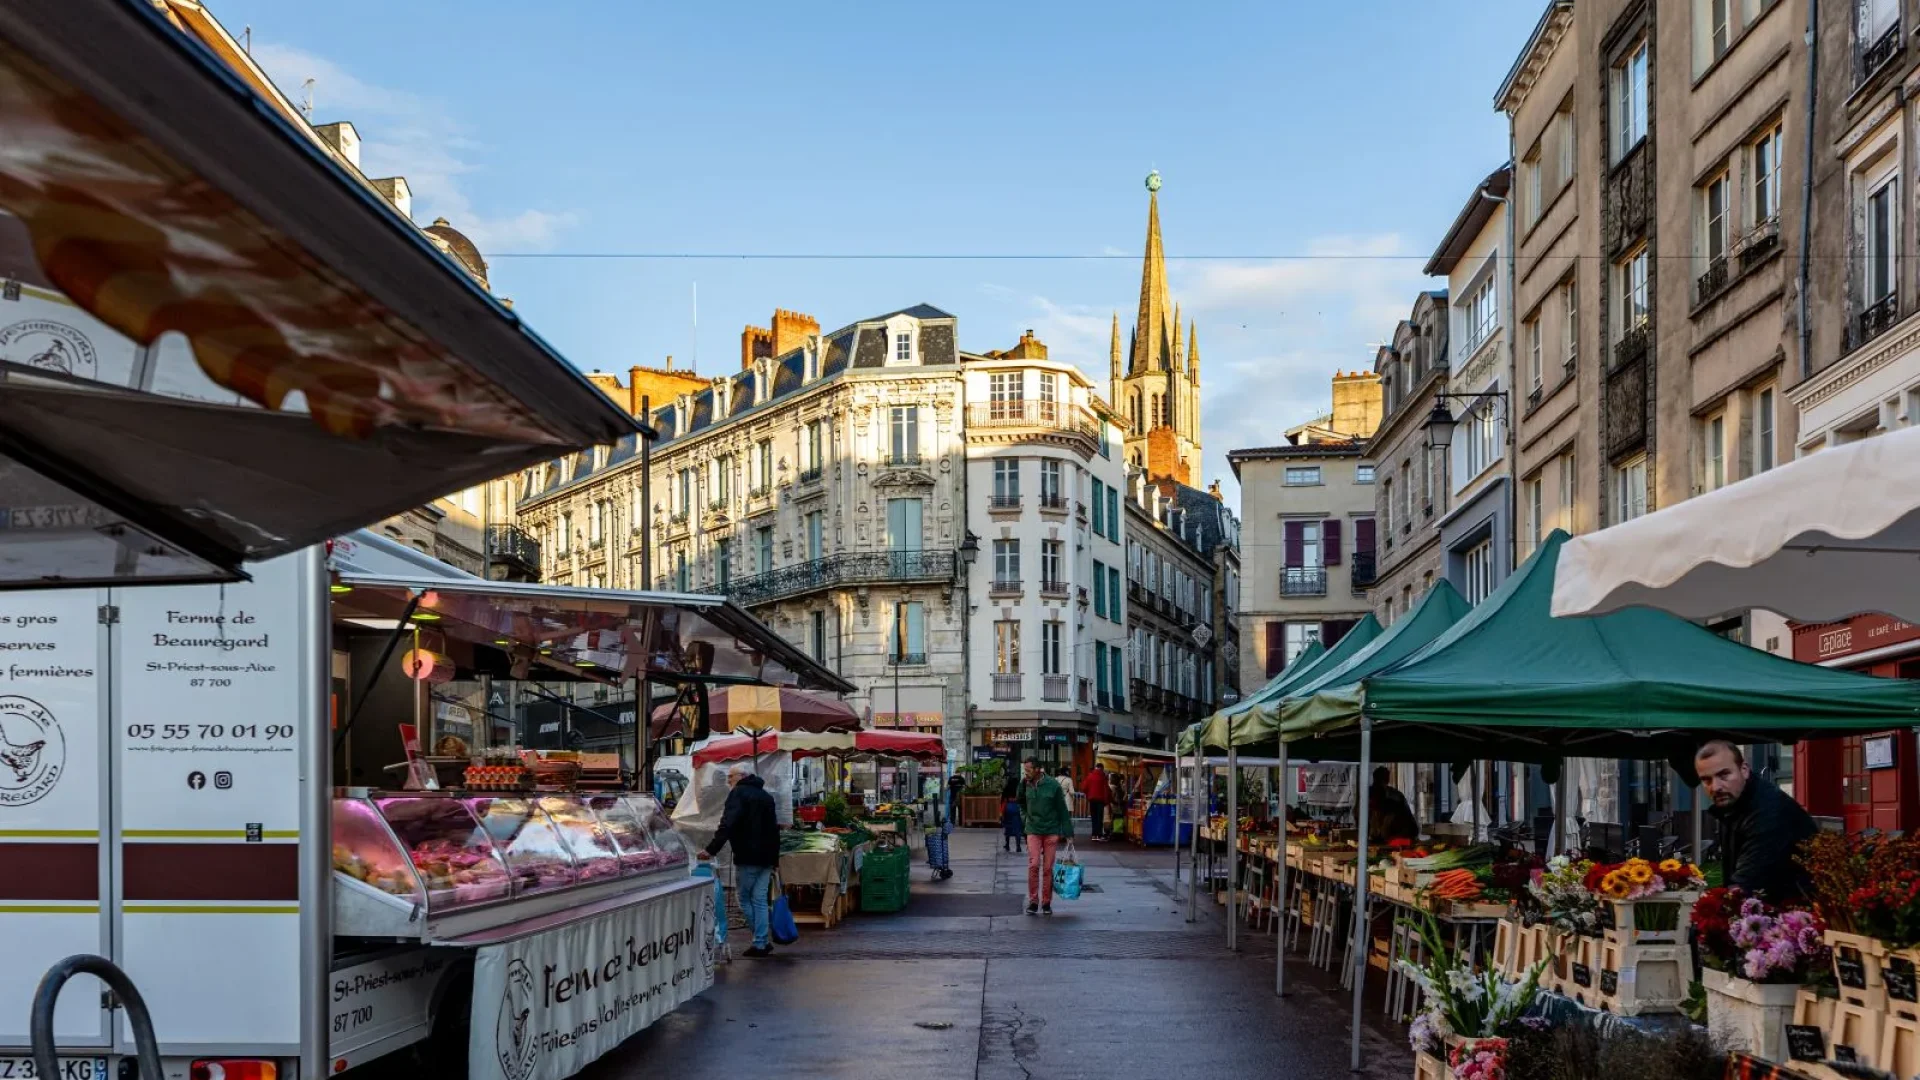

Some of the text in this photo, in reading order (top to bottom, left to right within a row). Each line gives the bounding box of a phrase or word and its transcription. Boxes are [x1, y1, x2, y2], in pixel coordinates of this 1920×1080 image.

[17, 615, 58, 628] gras
[166, 610, 255, 624] Ferme de
[0, 642, 56, 650] serves
[153, 633, 269, 651] Beauregard
[9, 664, 94, 681] fermières
[190, 678, 232, 687] 87 700
[127, 724, 294, 740] 05 55 70 01 90
[333, 1005, 373, 1033] 87 700
